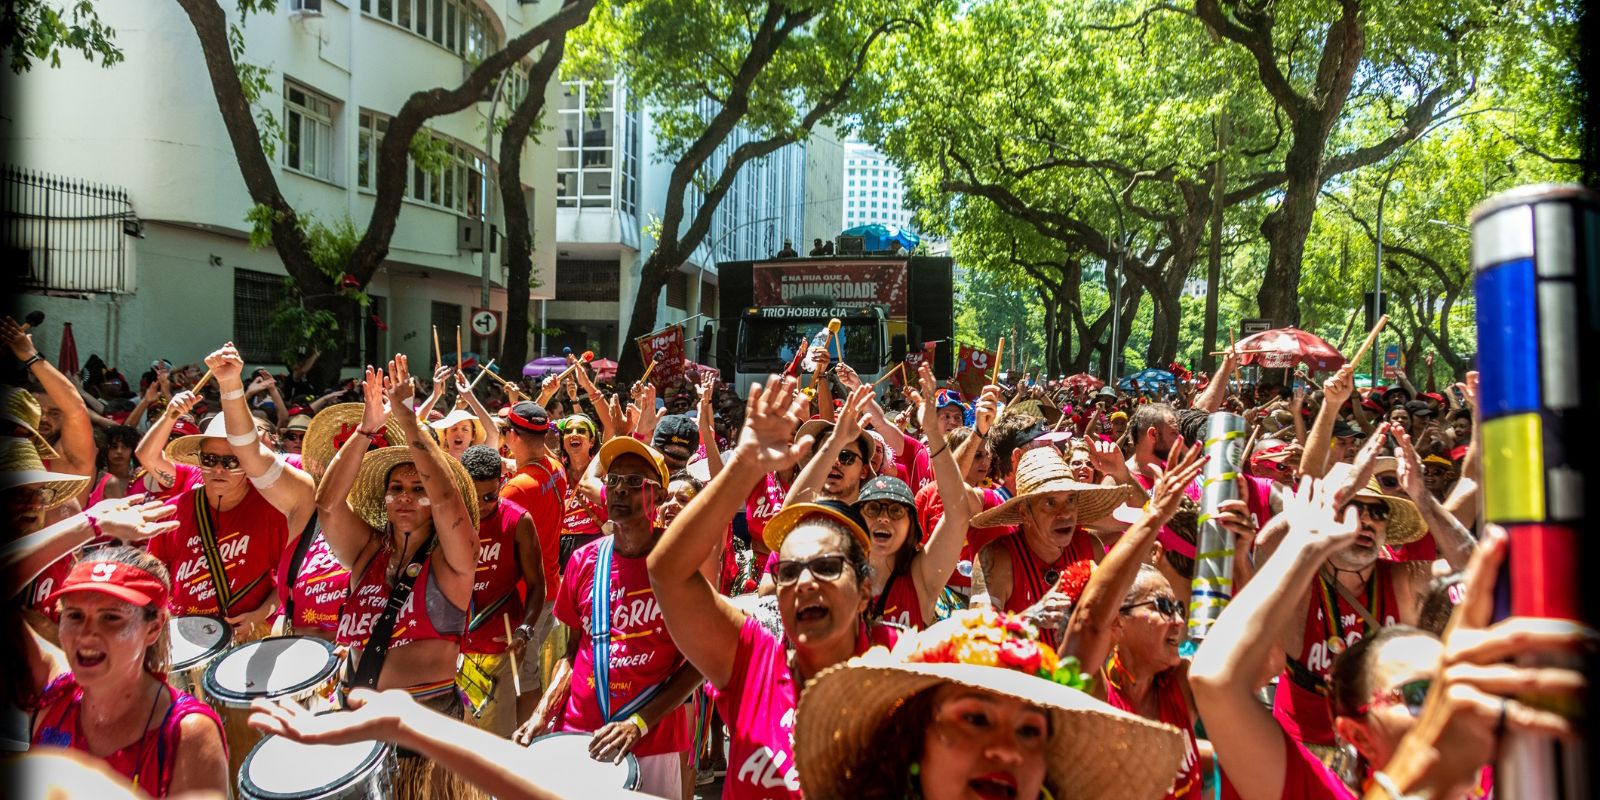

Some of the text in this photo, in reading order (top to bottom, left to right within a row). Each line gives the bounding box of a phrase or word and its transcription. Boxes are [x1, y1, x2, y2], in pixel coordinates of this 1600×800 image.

[781, 282, 878, 300] BRAHMOSIDADE
[762, 307, 785, 317] TRIO
[787, 307, 821, 317] HOBBY
[830, 307, 848, 317] CIA
[176, 535, 250, 582] ALERIA
[189, 581, 208, 595] DAR
[305, 582, 327, 596] DAR
[358, 584, 383, 597] AQUI
[316, 588, 347, 604] VENDE
[609, 651, 655, 669] ENDER!
